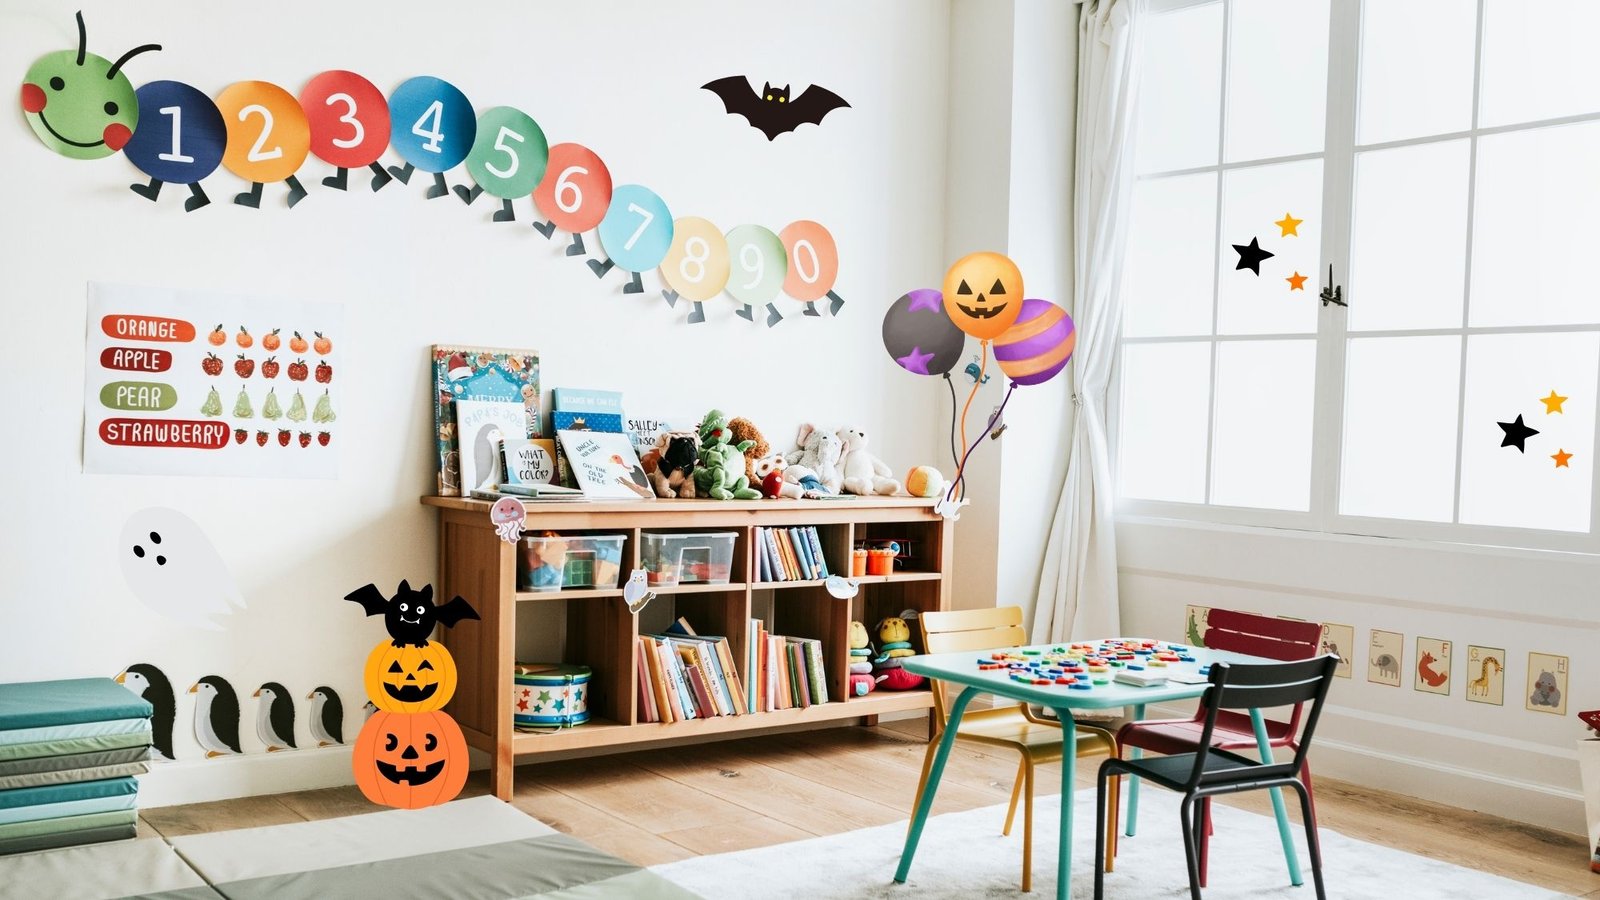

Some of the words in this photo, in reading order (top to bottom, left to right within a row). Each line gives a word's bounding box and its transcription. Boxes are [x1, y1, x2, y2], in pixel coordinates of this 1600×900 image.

[158, 105, 195, 164] 1
[237, 103, 283, 161] 2
[325, 92, 366, 149] 3
[411, 99, 445, 154] 4
[484, 126, 525, 179] 5
[554, 165, 589, 214] 6
[623, 202, 655, 251] 7
[679, 236, 711, 283] 8
[738, 243, 765, 290] 9
[792, 239, 821, 284] 0
[116, 317, 178, 339] ORANGE
[113, 349, 161, 371] APPLE
[116, 385, 162, 409] PEAR
[628, 419, 658, 431] SALLEY
[106, 422, 225, 446] STRAWBERRY
[576, 439, 595, 452] UNCLE
[518, 449, 544, 460] WHAT
[527, 460, 541, 470] MY
[519, 469, 549, 480] COLOR?
[588, 469, 604, 479] OLD
[587, 475, 606, 486] TREE
[1323, 625, 1330, 636] D
[1372, 631, 1379, 644] E
[1442, 642, 1449, 654] F
[1470, 648, 1479, 659] G
[1557, 659, 1565, 671] H
